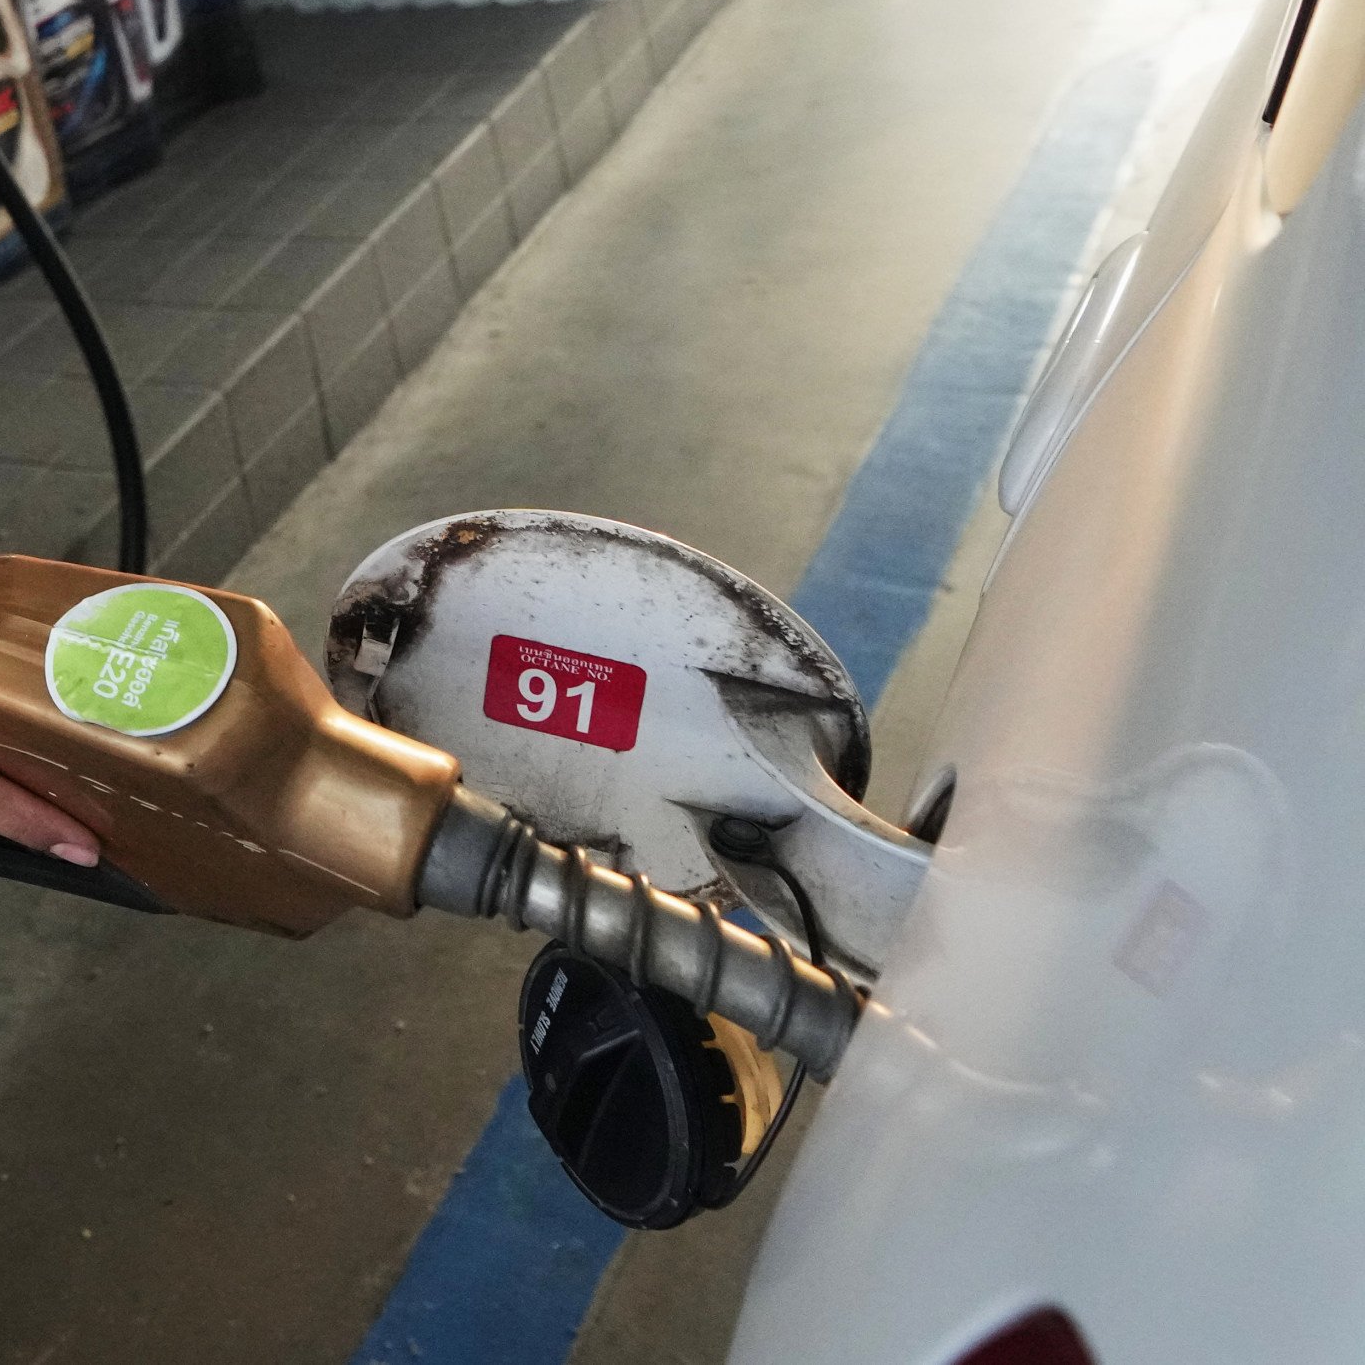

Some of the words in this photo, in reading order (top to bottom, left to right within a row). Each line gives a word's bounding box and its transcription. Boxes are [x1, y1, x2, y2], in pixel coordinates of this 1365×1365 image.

[92, 647, 137, 700] E20
[519, 645, 614, 674] เบนซินออกเทน
[520, 653, 581, 675] OCTANE
[587, 668, 612, 683] NO.
[516, 667, 597, 735] 91
[545, 967, 569, 1013] REMOVE
[530, 1010, 551, 1056] SLOWLY
